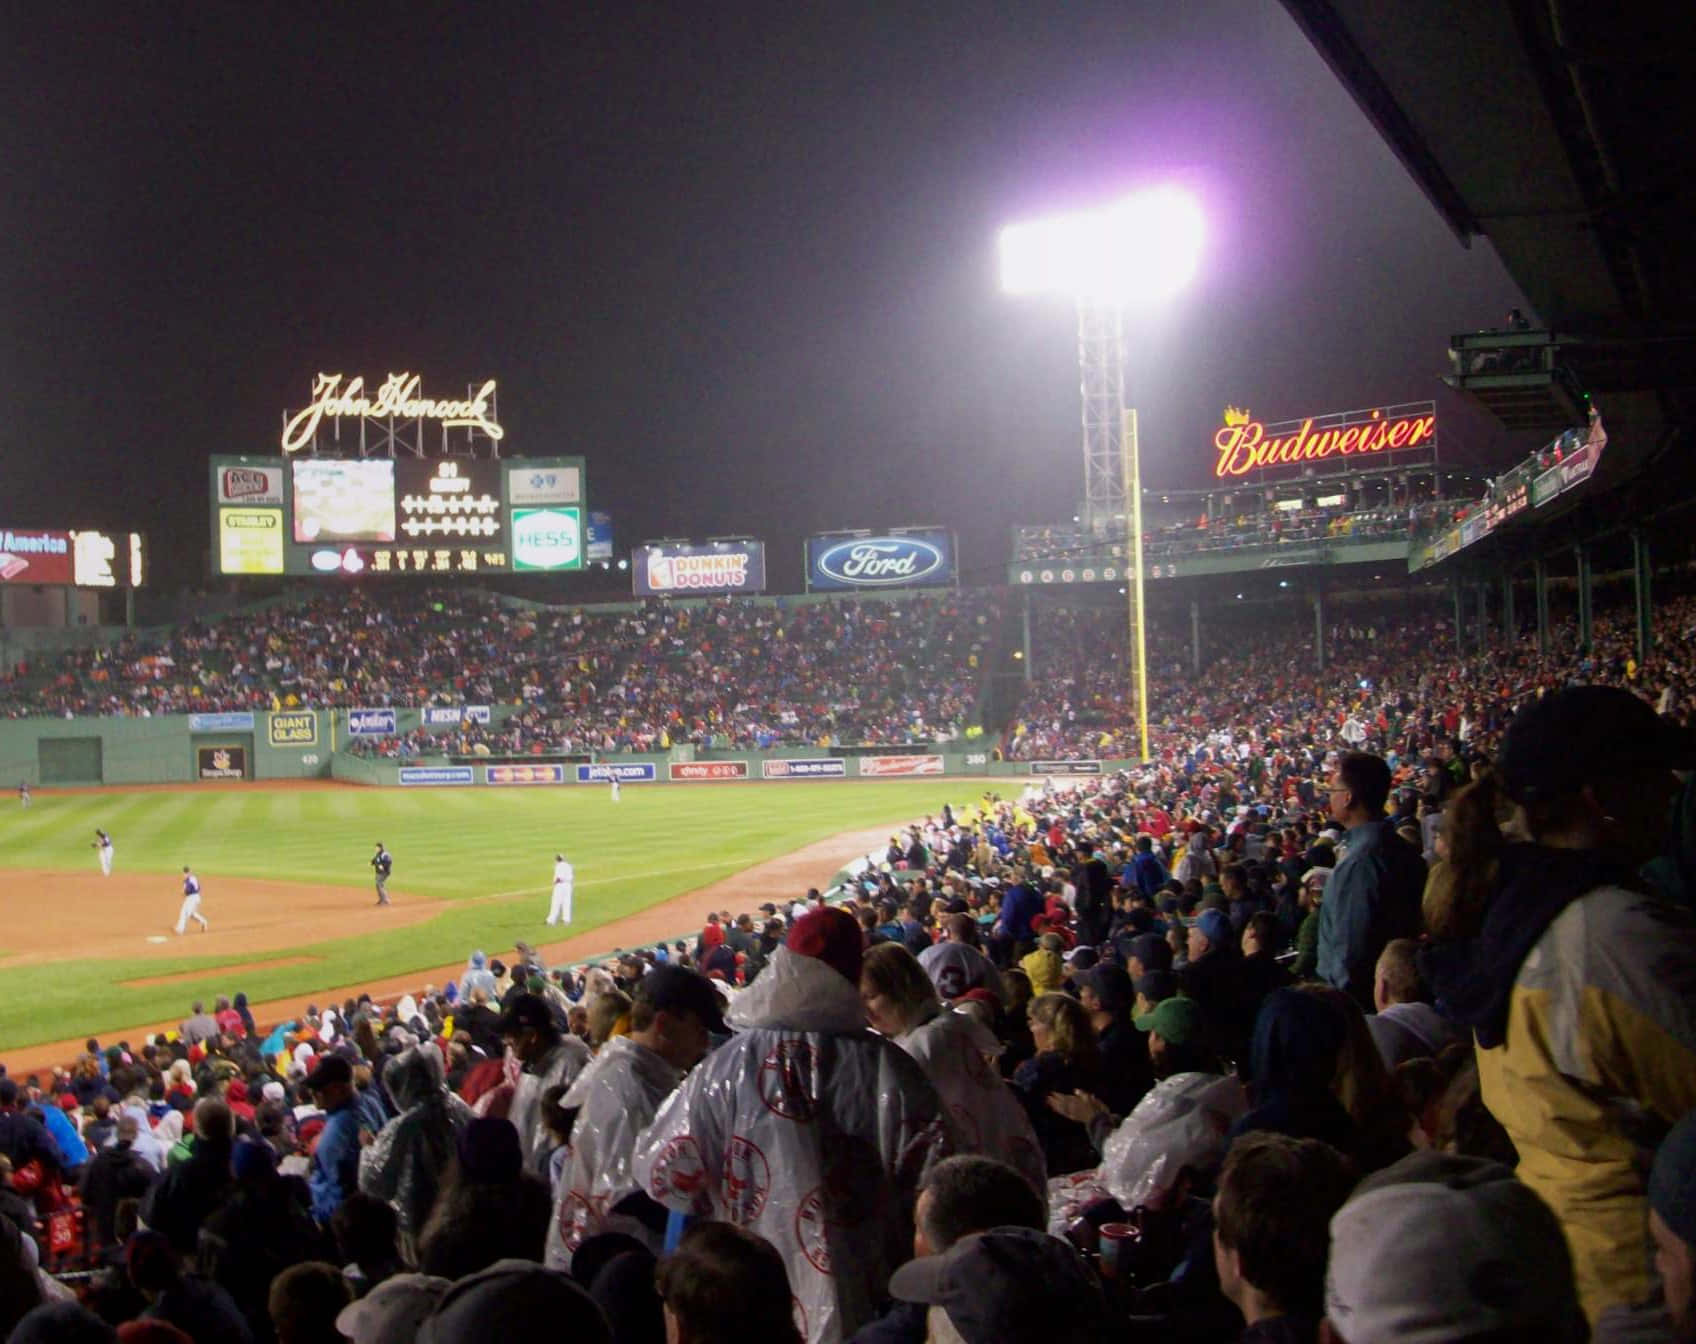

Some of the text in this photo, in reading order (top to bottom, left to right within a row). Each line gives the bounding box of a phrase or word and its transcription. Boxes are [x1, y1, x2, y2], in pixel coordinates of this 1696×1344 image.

[281, 371, 504, 451] John Hancock
[1215, 410, 1436, 477] Budweiser
[4, 531, 68, 554] America
[676, 553, 749, 572] DUNKIN'
[844, 544, 917, 576] Ford
[676, 570, 747, 587] DONUTS
[274, 717, 311, 729] GIANT
[274, 728, 312, 740] GLASS
[966, 754, 986, 765] 380
